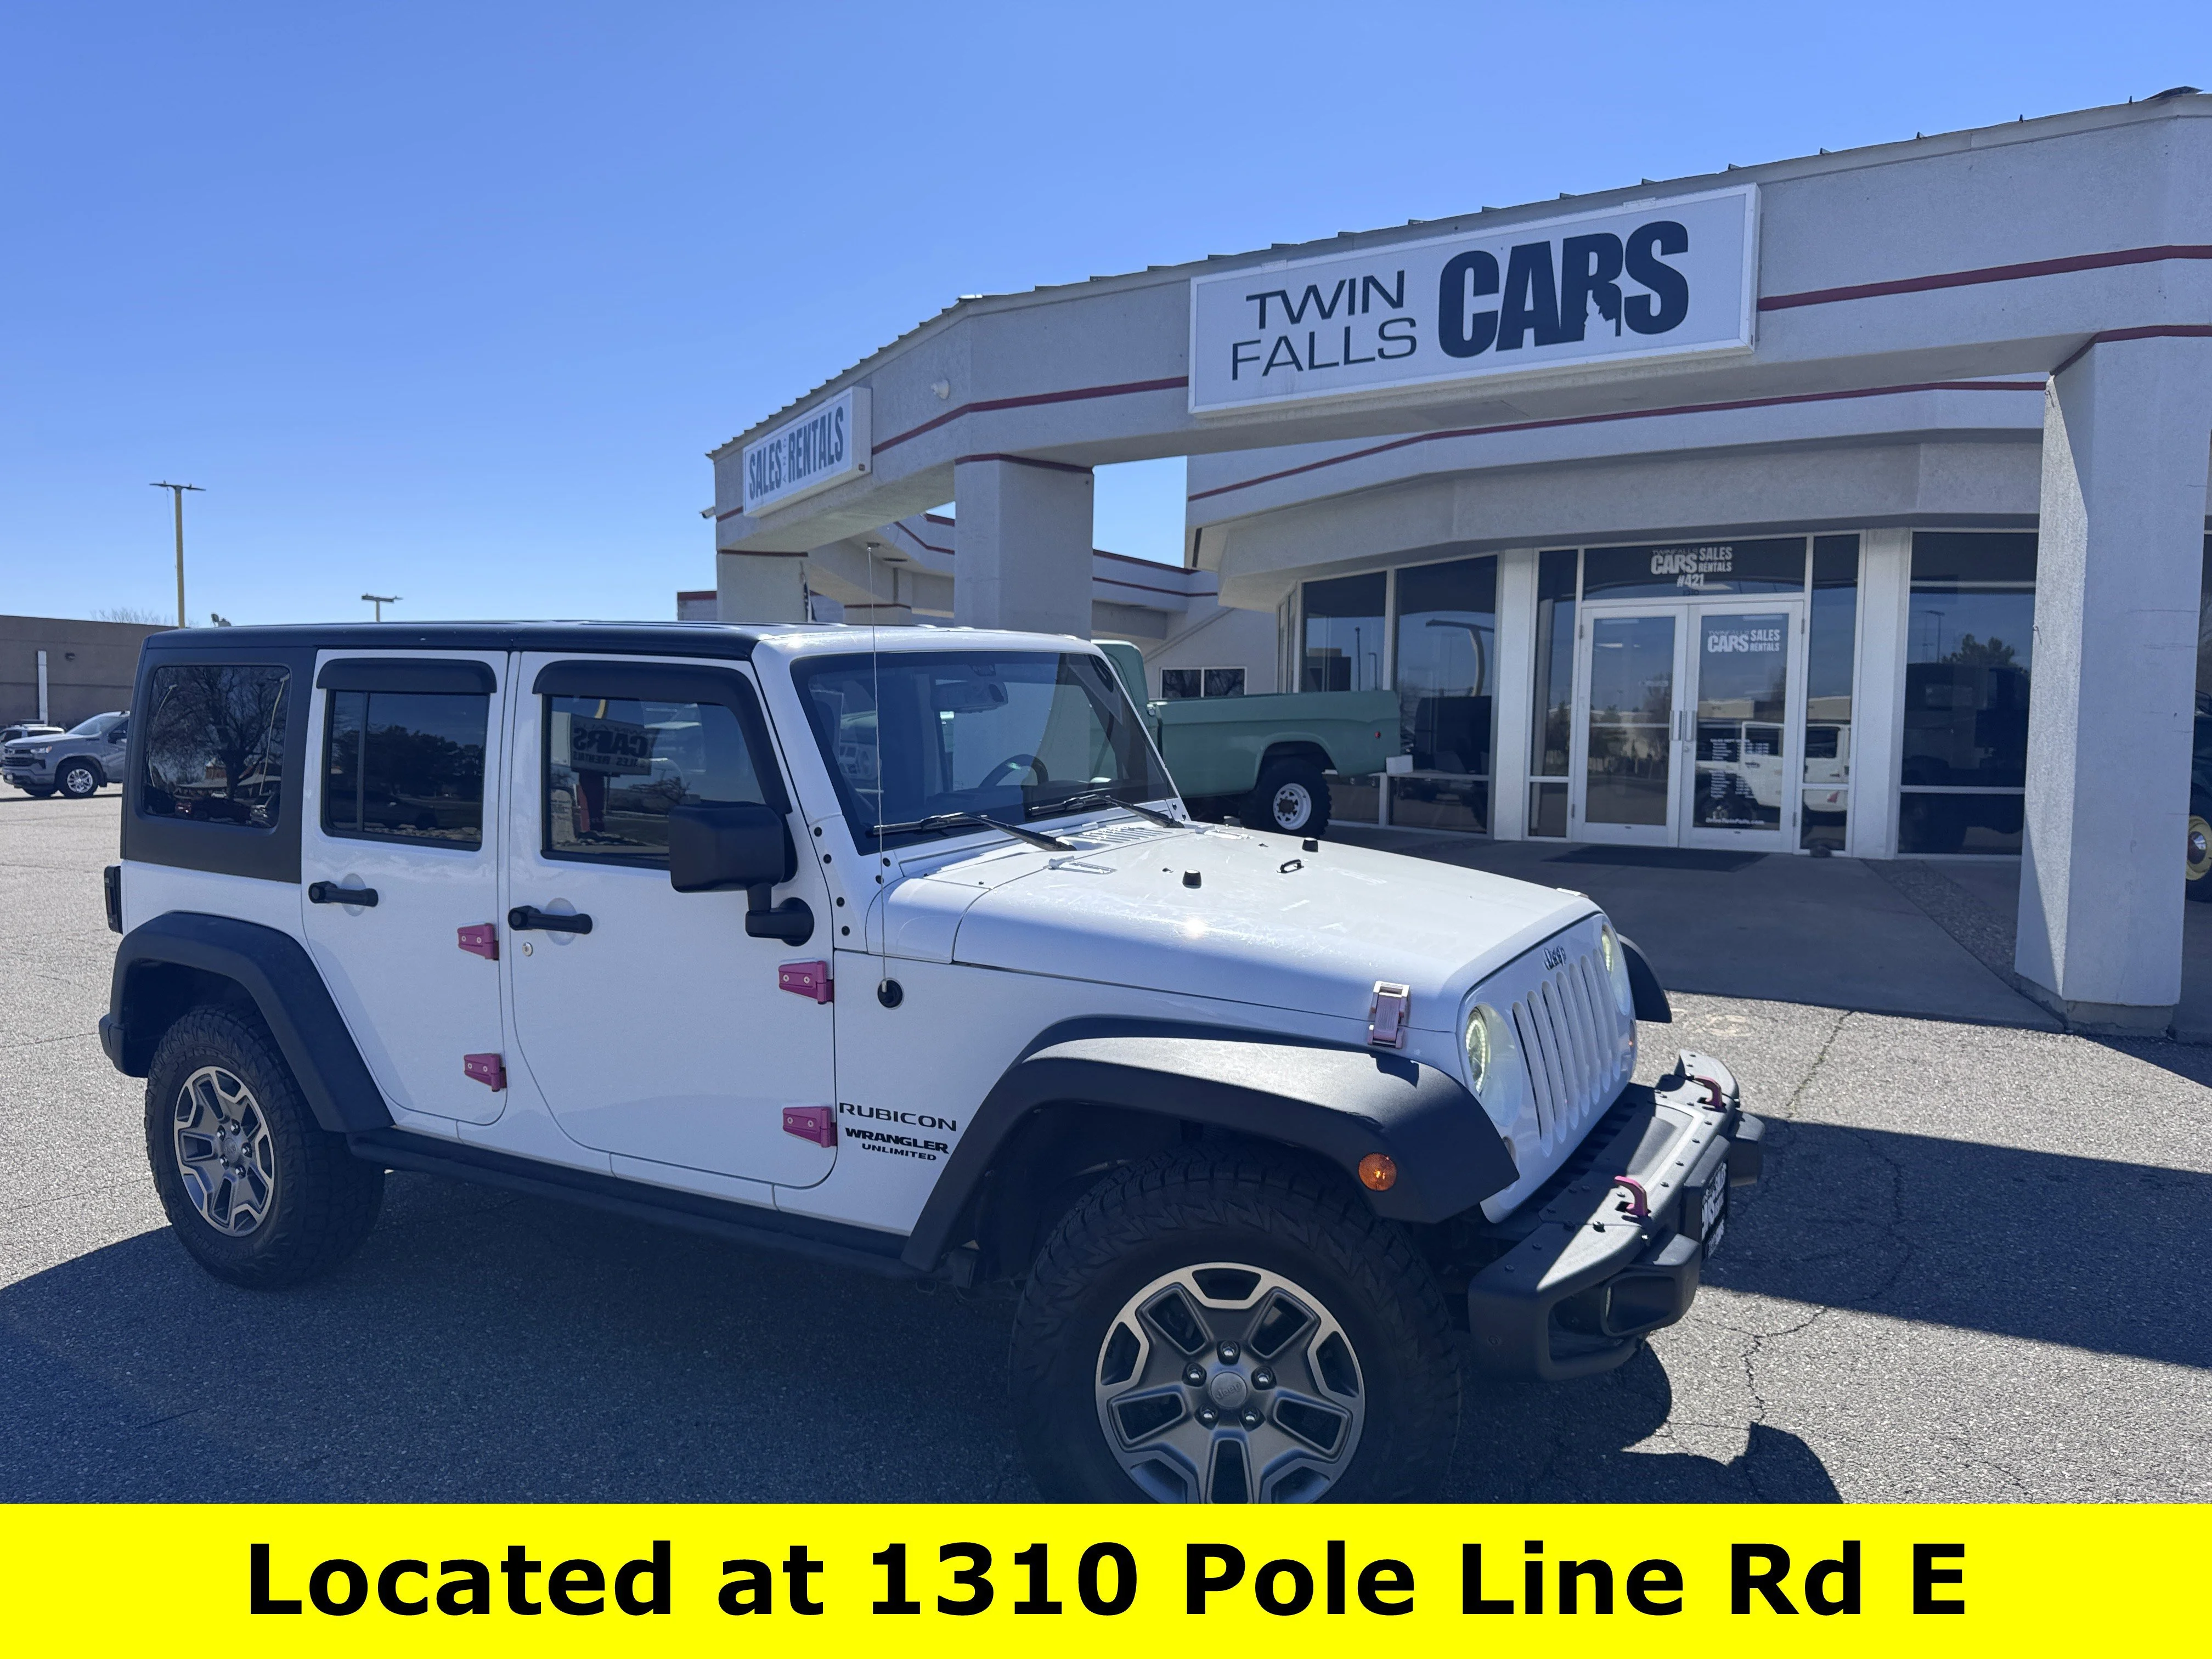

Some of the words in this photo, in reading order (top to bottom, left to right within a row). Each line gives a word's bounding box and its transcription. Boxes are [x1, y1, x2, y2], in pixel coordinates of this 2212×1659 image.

[1438, 220, 1689, 358] CARS
[1245, 269, 1405, 330] TWIN
[1232, 317, 1417, 381] FALLS
[749, 439, 782, 500] SALES
[788, 406, 844, 483] RENTALS
[1699, 546, 1733, 561] SALES
[1651, 554, 1697, 574] CARS
[1698, 561, 1732, 573] RENTALS
[1677, 573, 1705, 588] #421
[1707, 634, 1749, 653] CARS
[1750, 629, 1780, 641] SALES
[1750, 642, 1780, 652] RENTALS
[839, 1102, 957, 1132] RUBICON
[845, 1127, 950, 1154] WRANGLER
[862, 1143, 937, 1161] UNLIMITED
[1215, 1381, 1242, 1400] Jeep
